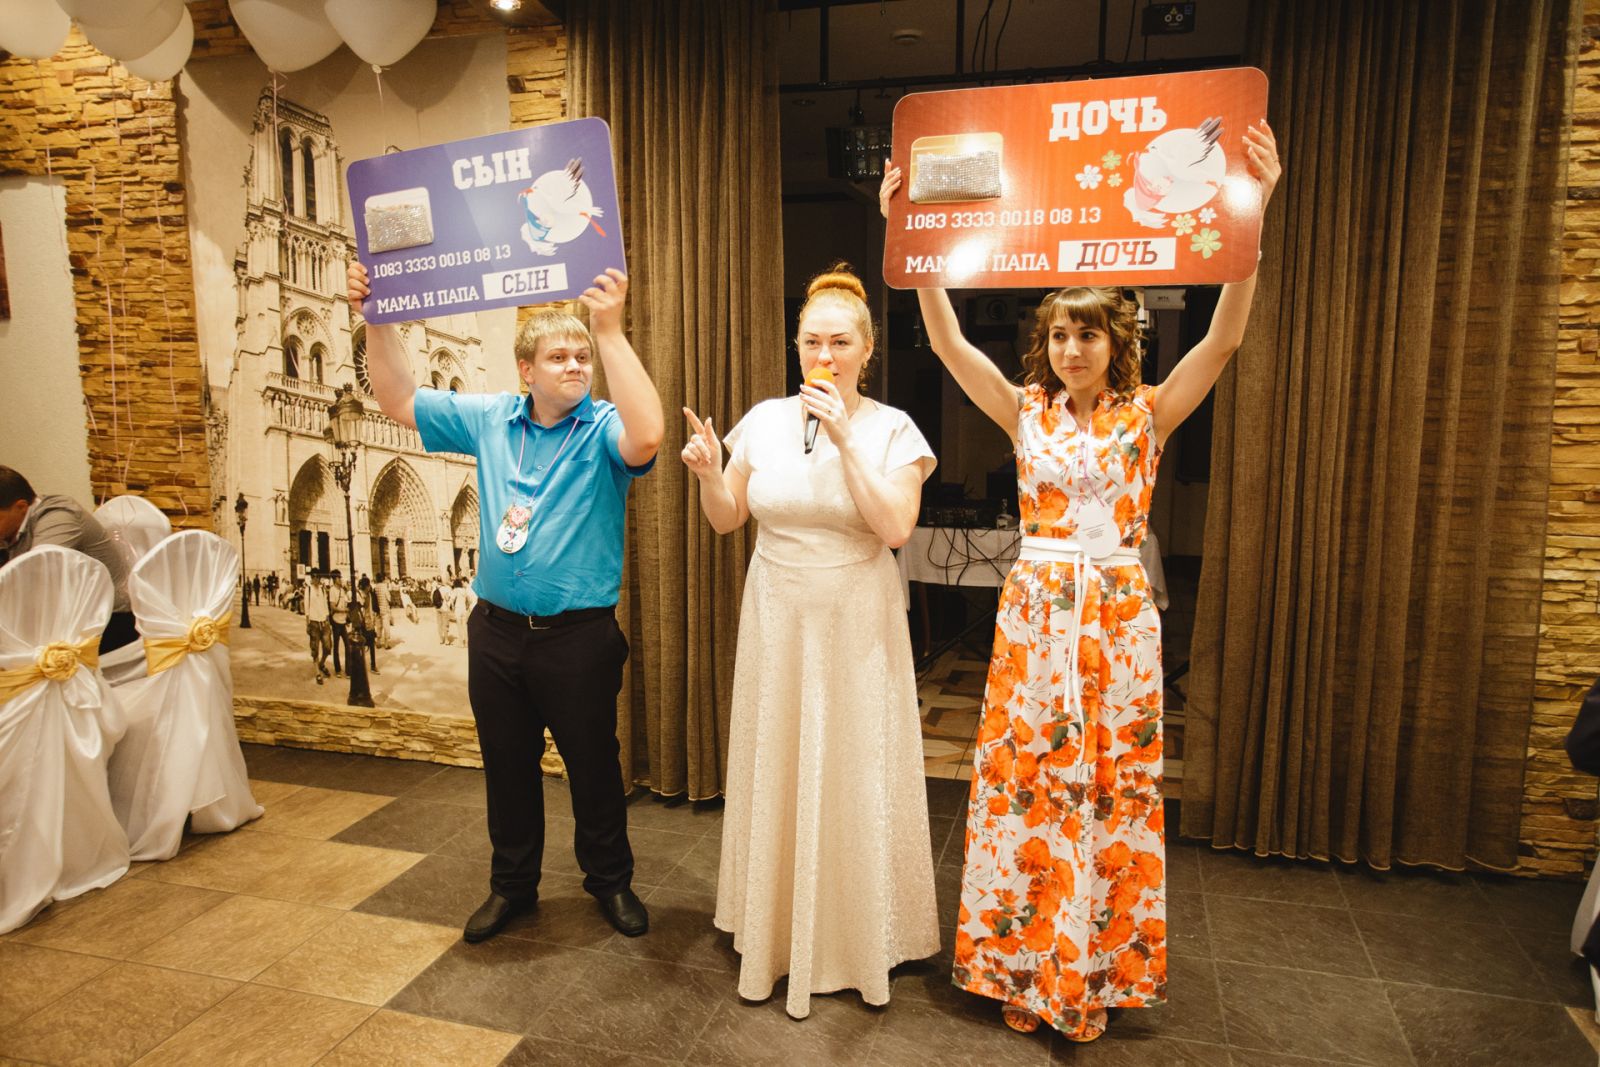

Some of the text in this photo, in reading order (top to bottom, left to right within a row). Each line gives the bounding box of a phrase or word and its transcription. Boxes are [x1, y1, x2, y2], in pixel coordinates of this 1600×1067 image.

[1049, 97, 1167, 141] ДОЧЬ
[452, 148, 532, 190] СЫН
[905, 208, 1101, 231] 1083 3333 0018 08 13
[374, 244, 511, 279] 1083 3333 0018 08 13
[905, 255, 966, 273] МАМ
[992, 253, 1050, 271] ПАПА
[1076, 240, 1158, 270] ДОЧЬ
[502, 270, 549, 294] СЫН
[377, 286, 480, 314] МАМА И ПАПА
